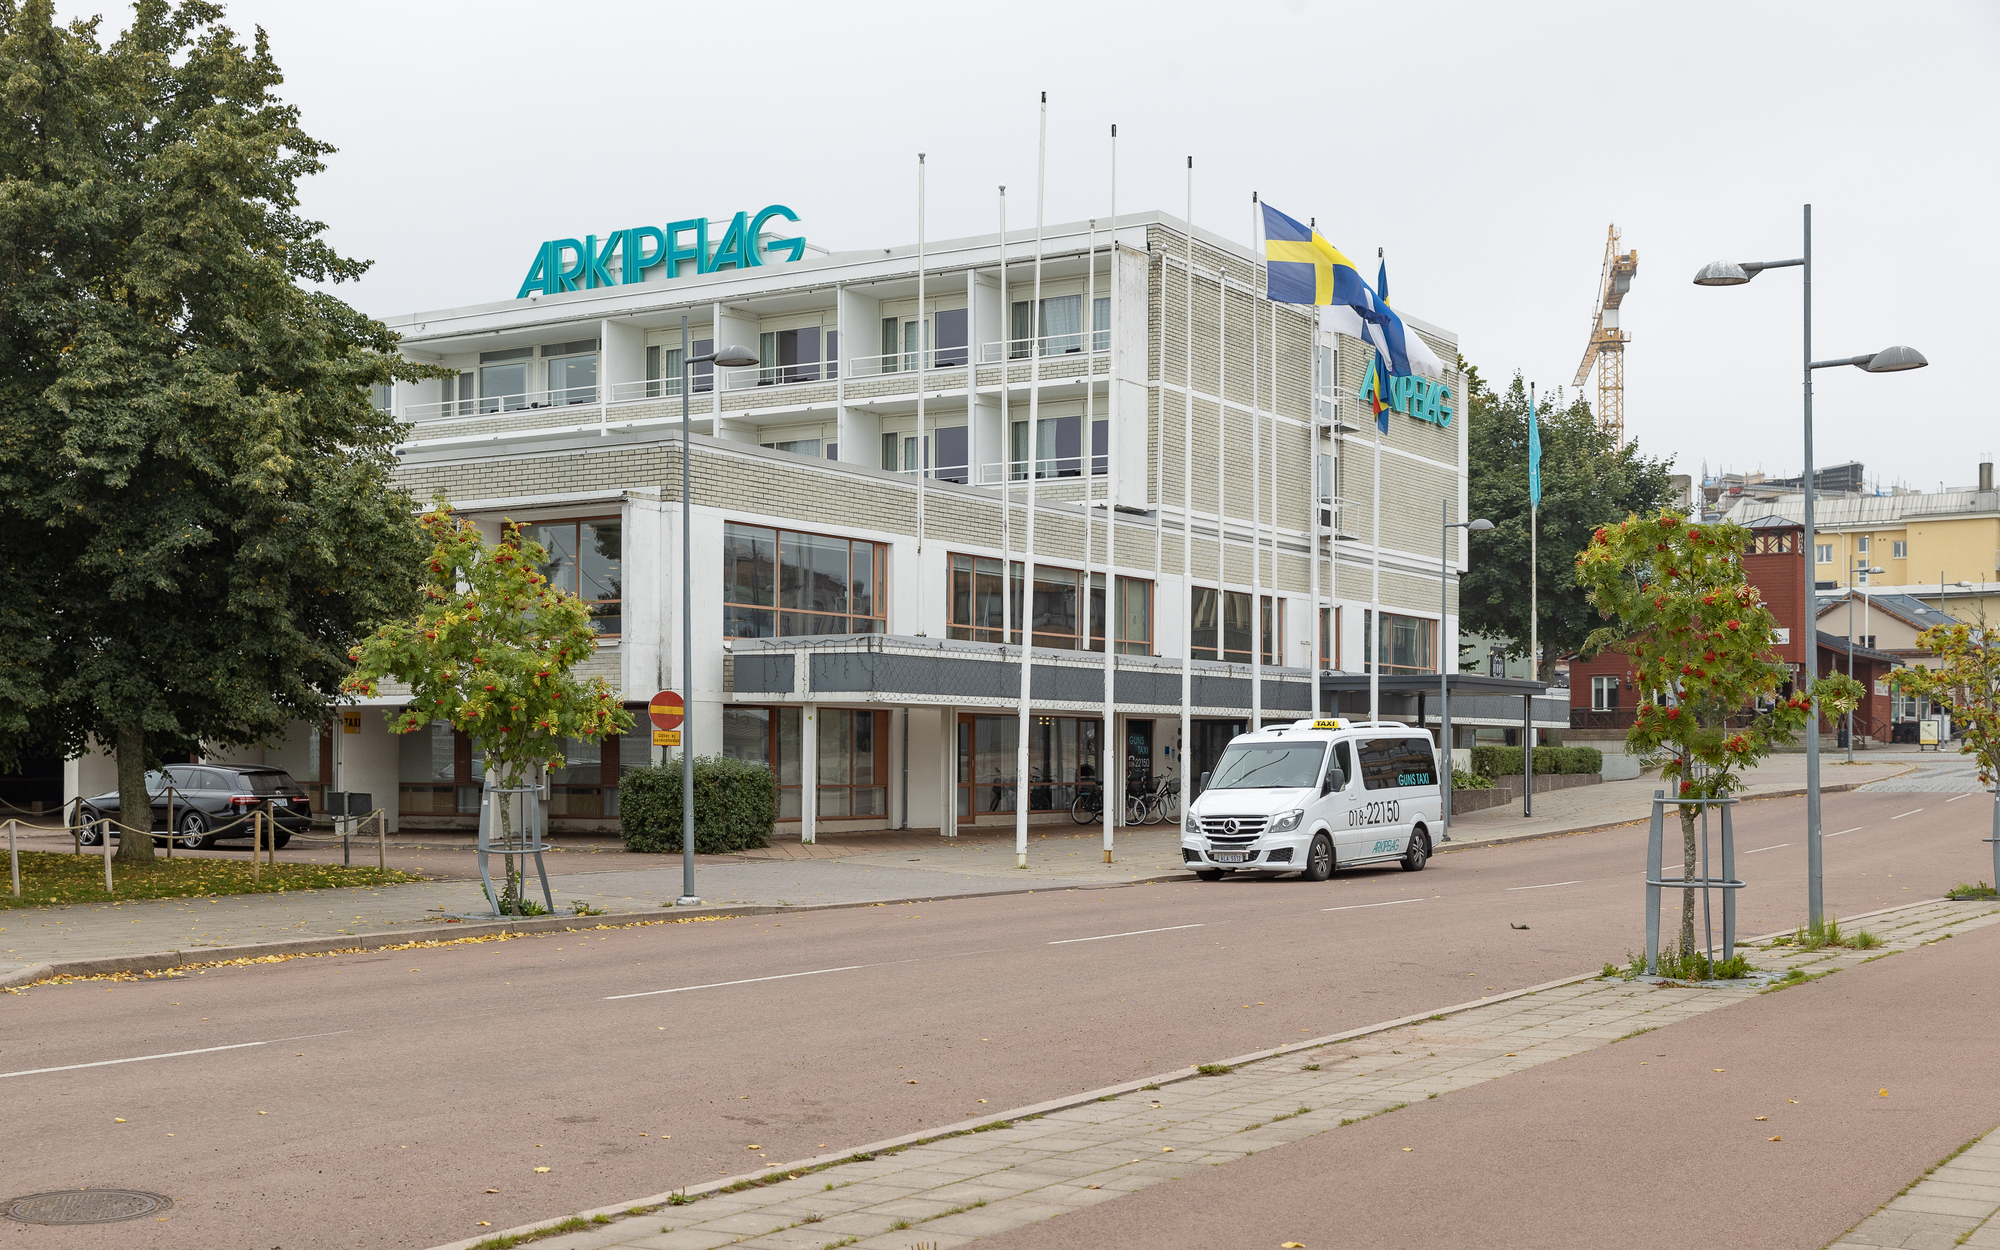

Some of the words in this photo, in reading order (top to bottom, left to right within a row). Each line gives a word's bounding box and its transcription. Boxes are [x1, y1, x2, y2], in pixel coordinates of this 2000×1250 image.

[1359, 360, 1453, 427] AKIPELAG
[1129, 735, 1145, 745] GUNS
[1137, 745, 1149, 755] TAXI
[1398, 773, 1416, 786] GUNS
[1416, 772, 1430, 785] TAXI
[1348, 800, 1400, 827] 018-22150
[1372, 838, 1400, 854] ARKIPELAG
